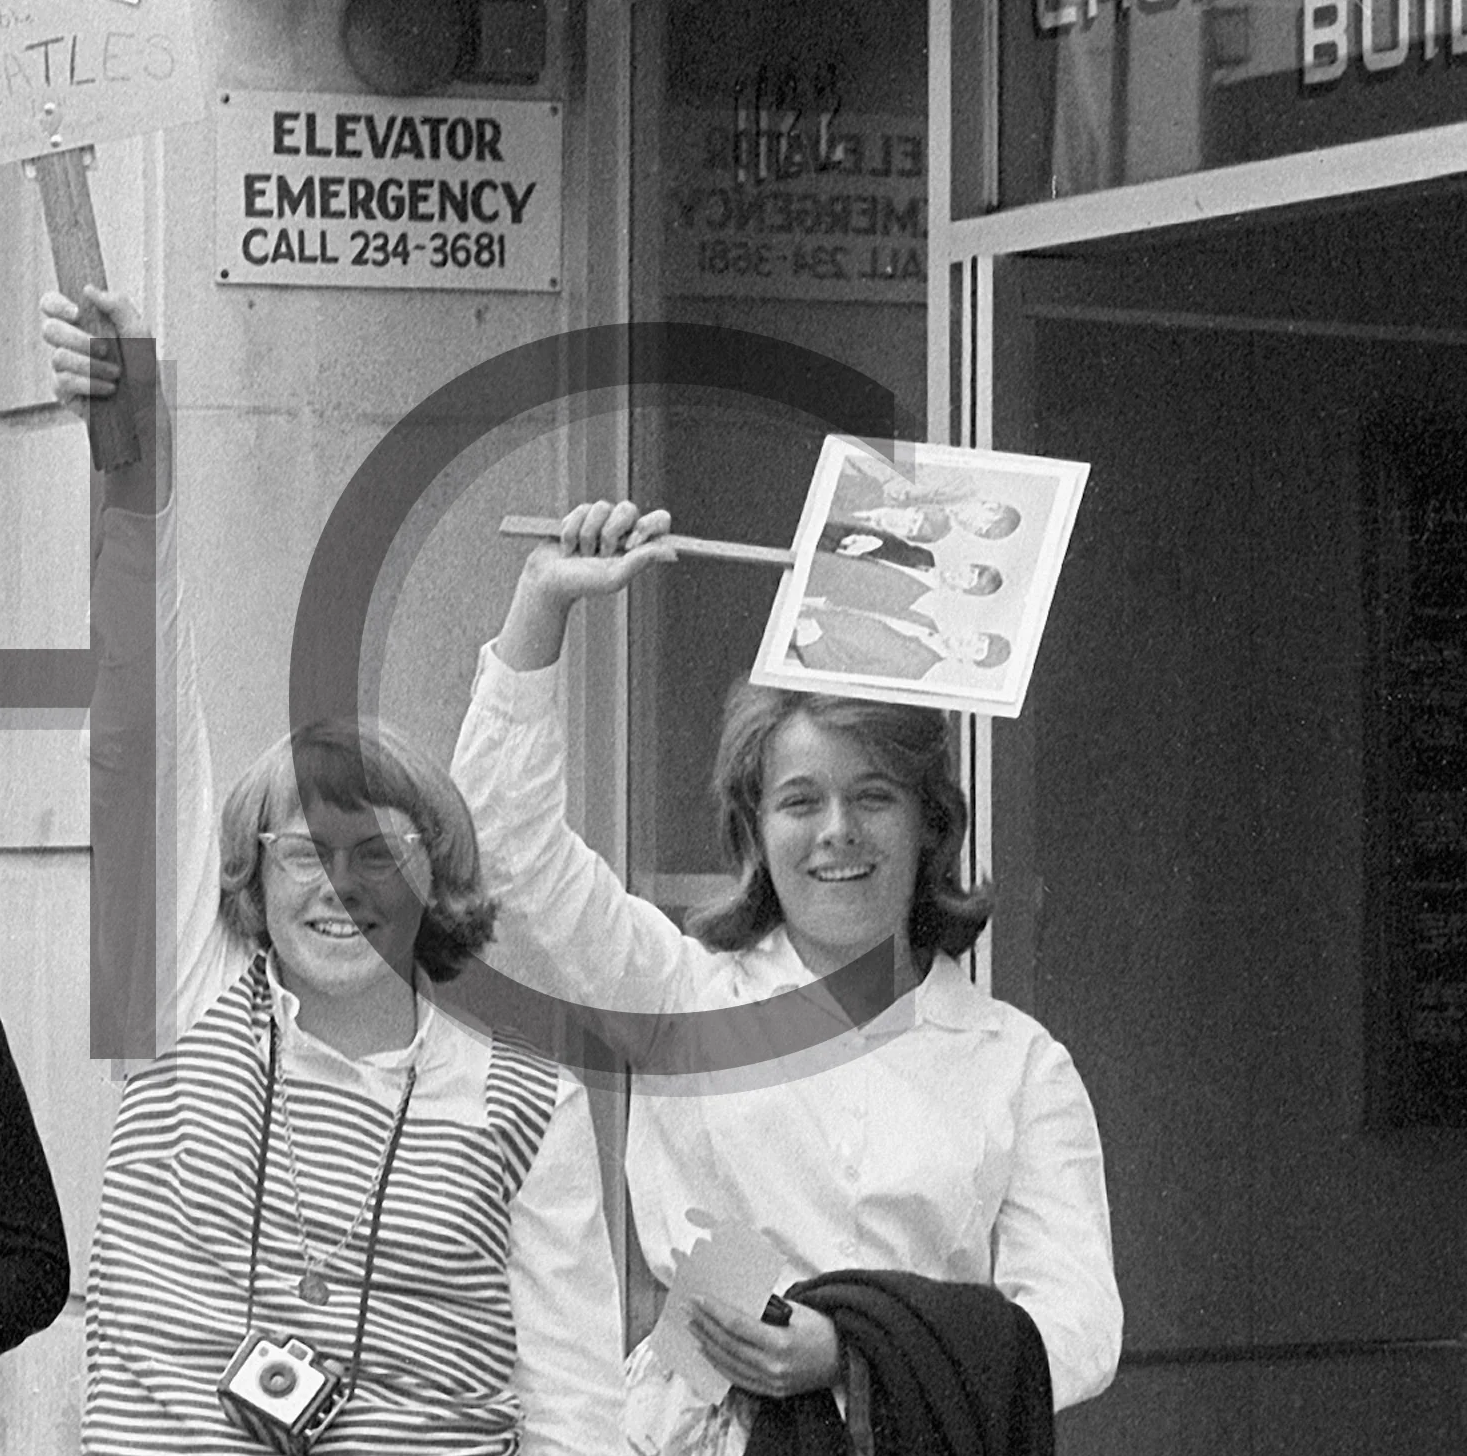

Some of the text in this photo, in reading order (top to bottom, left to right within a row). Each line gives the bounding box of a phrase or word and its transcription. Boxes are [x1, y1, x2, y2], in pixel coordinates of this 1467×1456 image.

[272, 111, 505, 162] ELEVATOR
[243, 173, 537, 224] EMERGENCY
[241, 228, 506, 269] CALL 234-3681
